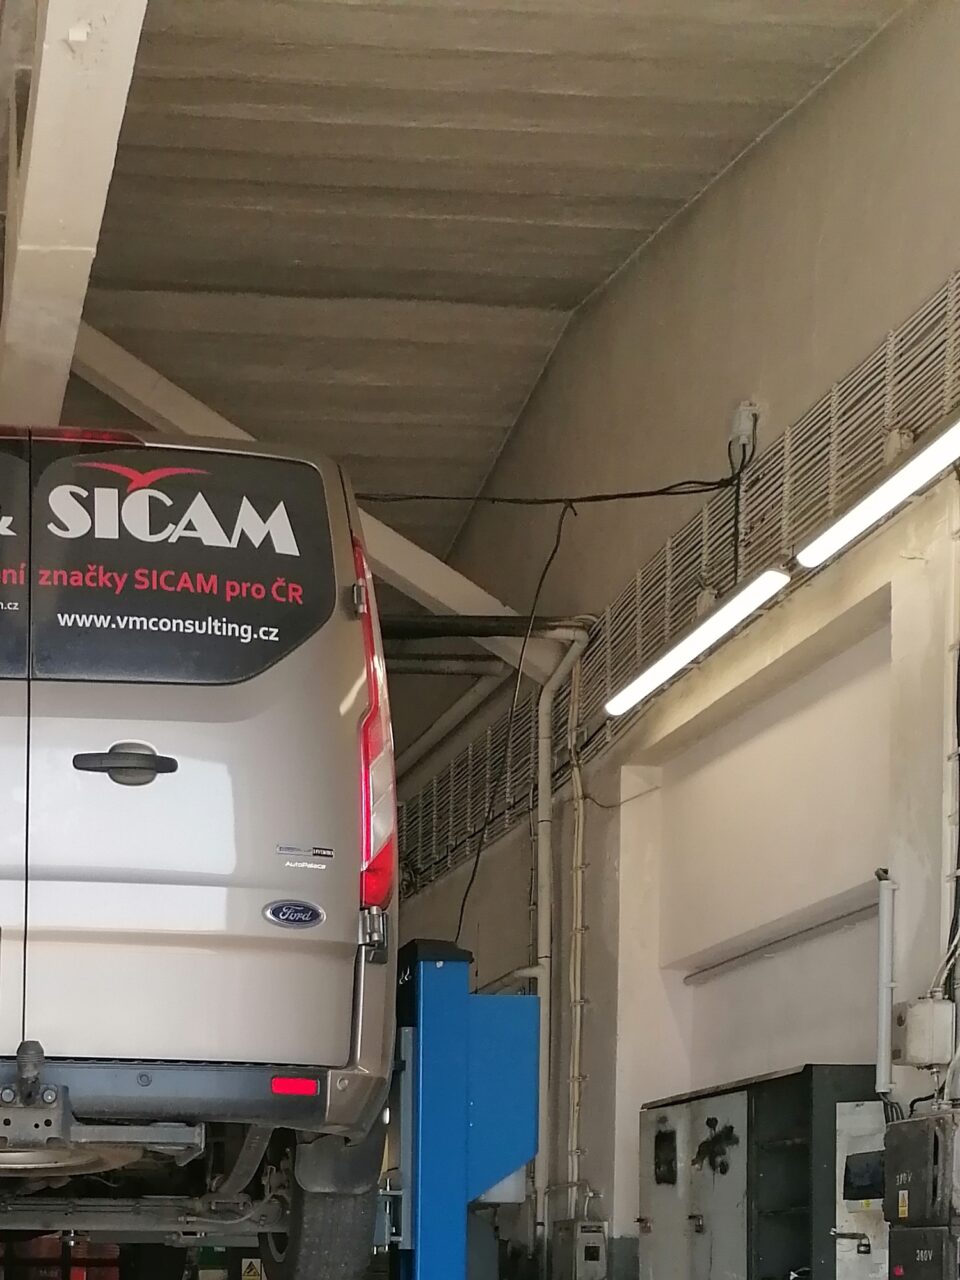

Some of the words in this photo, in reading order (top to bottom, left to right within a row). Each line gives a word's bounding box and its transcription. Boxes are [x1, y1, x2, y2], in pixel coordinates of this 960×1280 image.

[47, 484, 300, 557] SICAM
[38, 564, 128, 594] značky
[134, 568, 218, 595] SICAM
[225, 581, 266, 602] pro
[271, 577, 304, 605] ČR
[57, 612, 280, 643] www.vmconsulting.cz
[279, 904, 313, 921] Ford
